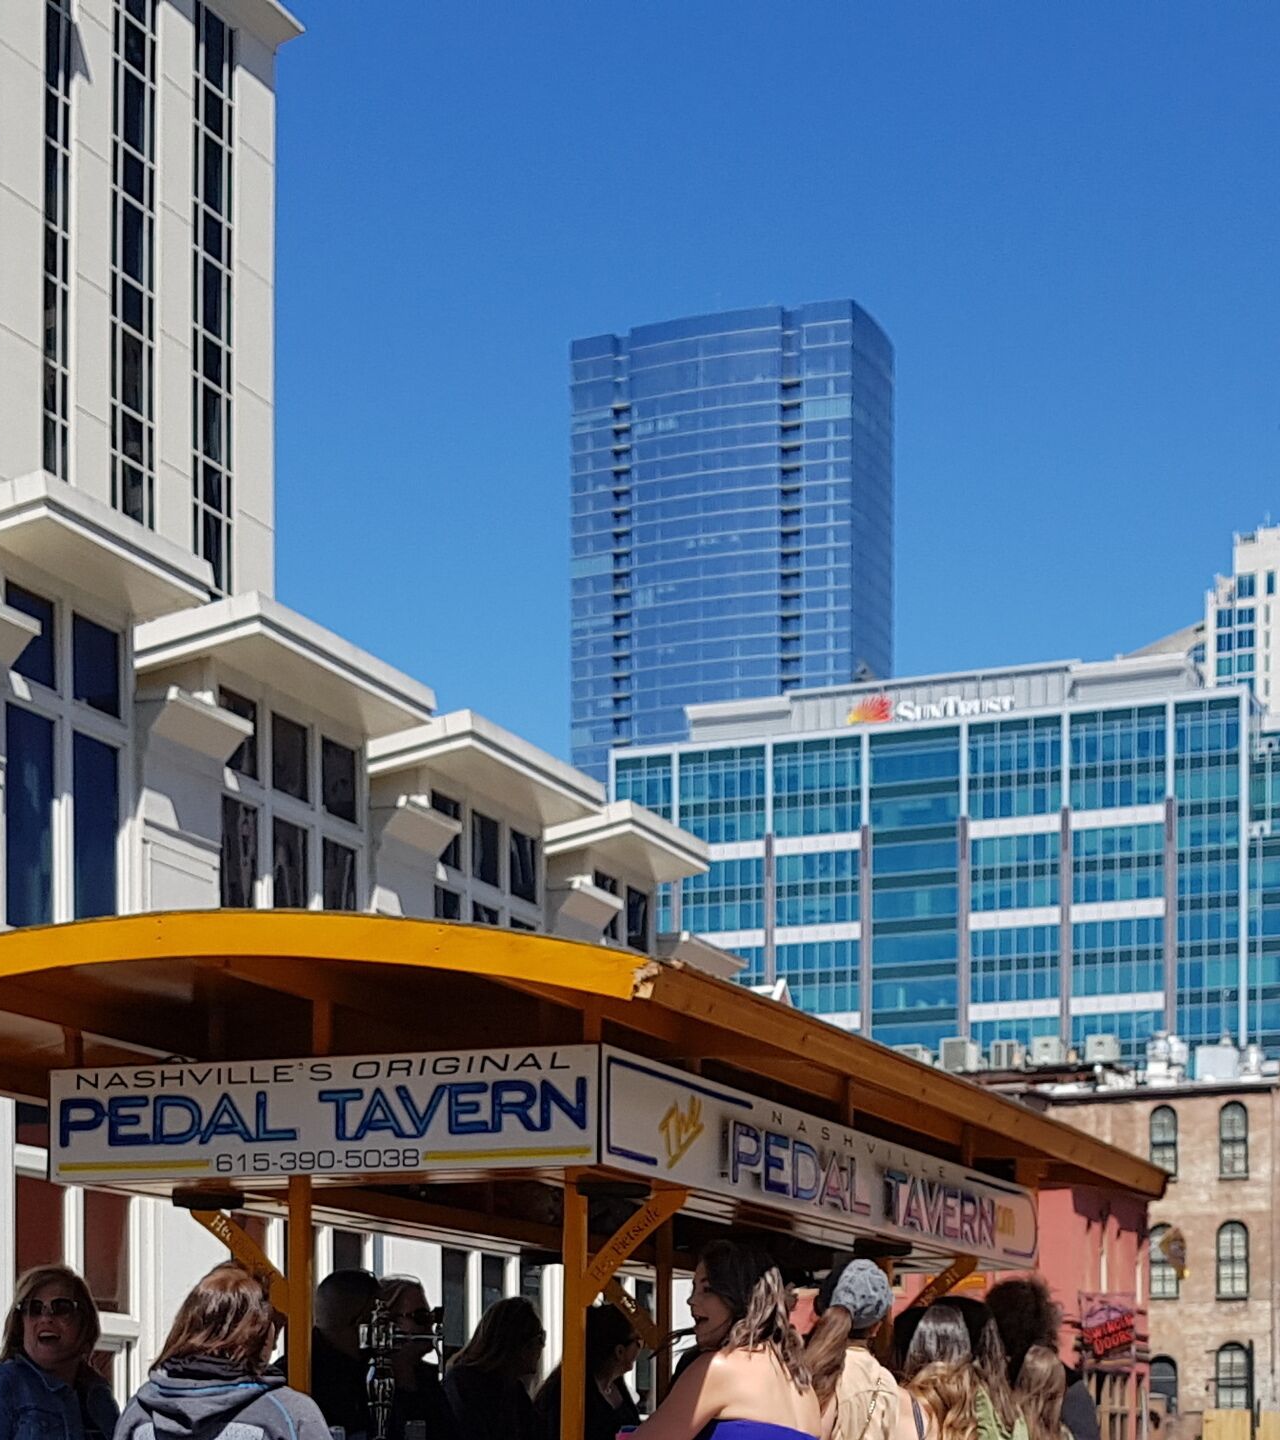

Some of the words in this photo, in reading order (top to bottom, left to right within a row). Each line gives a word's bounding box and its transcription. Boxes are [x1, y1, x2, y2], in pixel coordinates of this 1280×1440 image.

[75, 1061, 332, 1091] NASHVILLE'S
[352, 1051, 571, 1081] ORIGINAL
[59, 1090, 299, 1147] PEDAL
[318, 1075, 588, 1141] TAVERN
[771, 1109, 946, 1179] NASHVILLE
[215, 1148, 421, 1173] 615-390-5038
[729, 1119, 872, 1216] PEDAL
[882, 1168, 997, 1249] TAVERN
